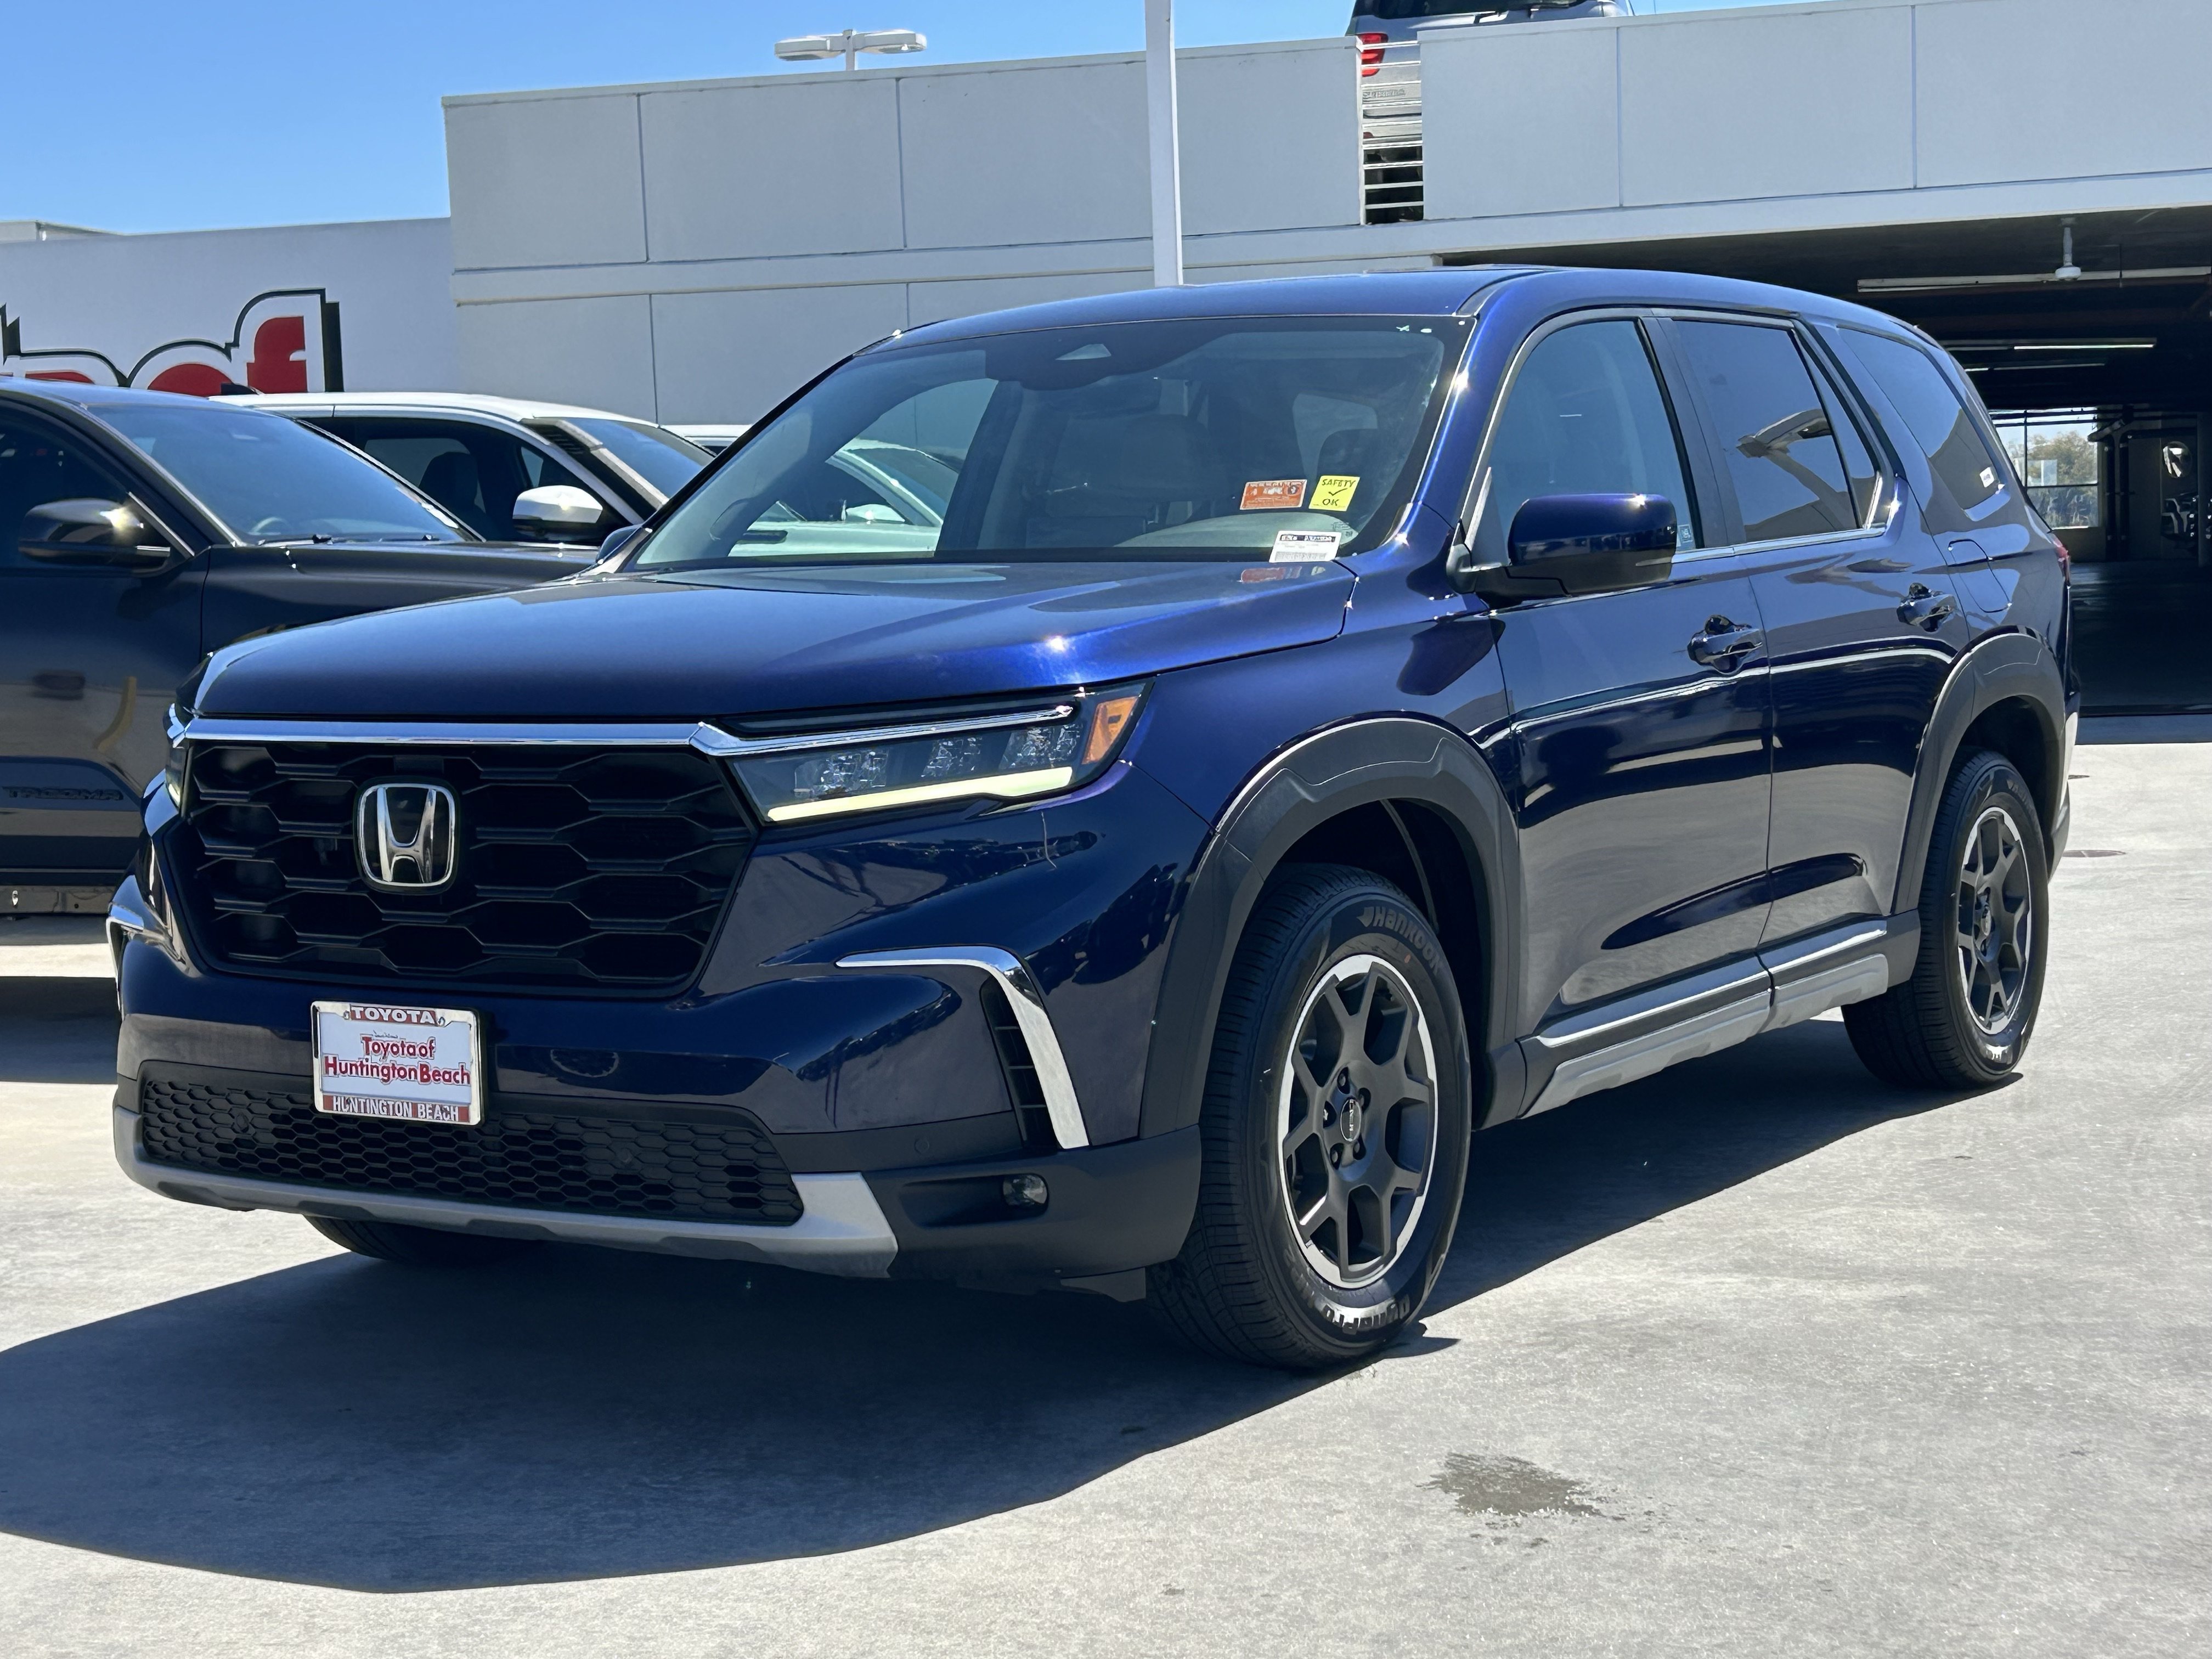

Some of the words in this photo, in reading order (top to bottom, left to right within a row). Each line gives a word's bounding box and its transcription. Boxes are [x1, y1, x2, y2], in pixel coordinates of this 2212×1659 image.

[1322, 498, 1340, 506] OK
[351, 1006, 435, 1024] TOYOTA
[333, 1096, 412, 1118] HUNTINGTON
[417, 1103, 459, 1121] BEACH
